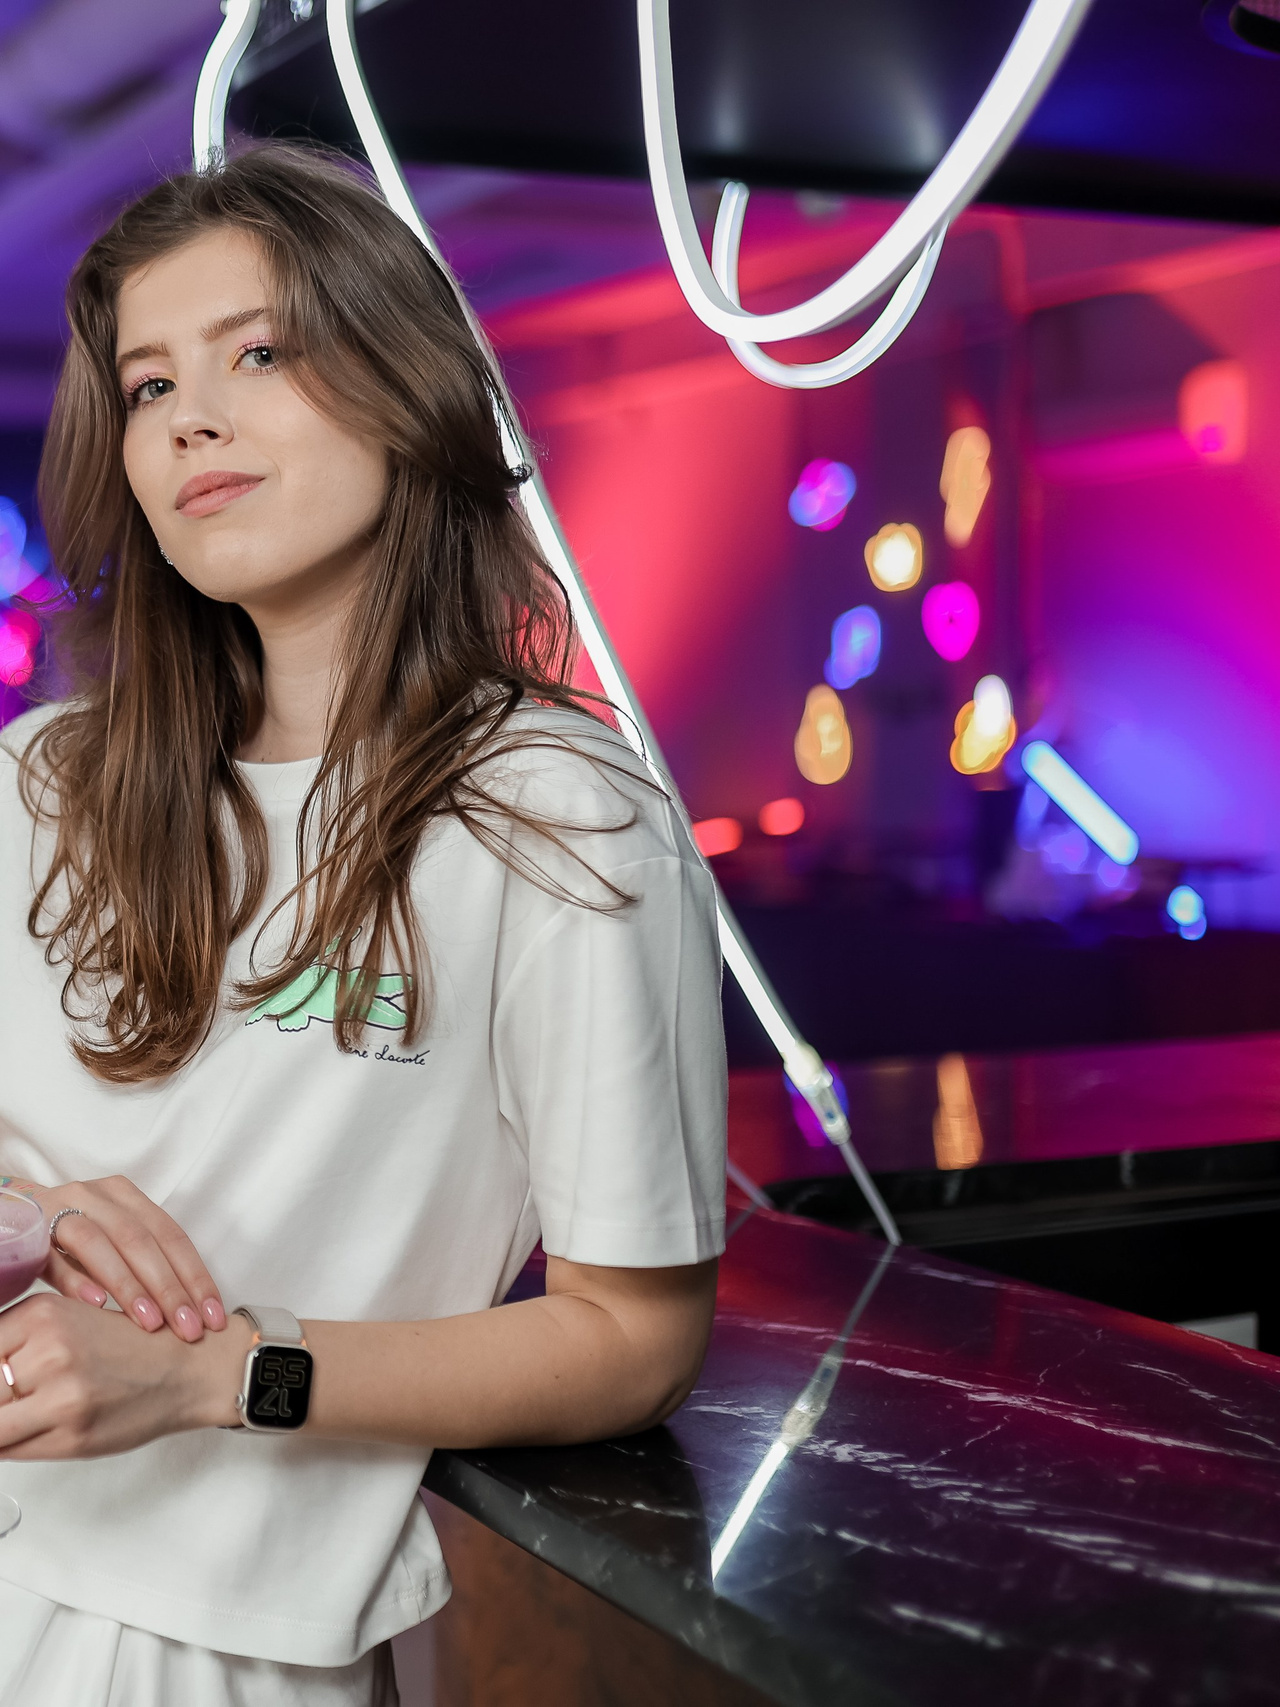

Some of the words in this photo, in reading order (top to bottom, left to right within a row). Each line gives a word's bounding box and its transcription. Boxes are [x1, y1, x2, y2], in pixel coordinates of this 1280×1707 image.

[374, 1044, 431, 1066] Lacoste
[258, 1355, 307, 1388] 59
[254, 1387, 293, 1418] 17
